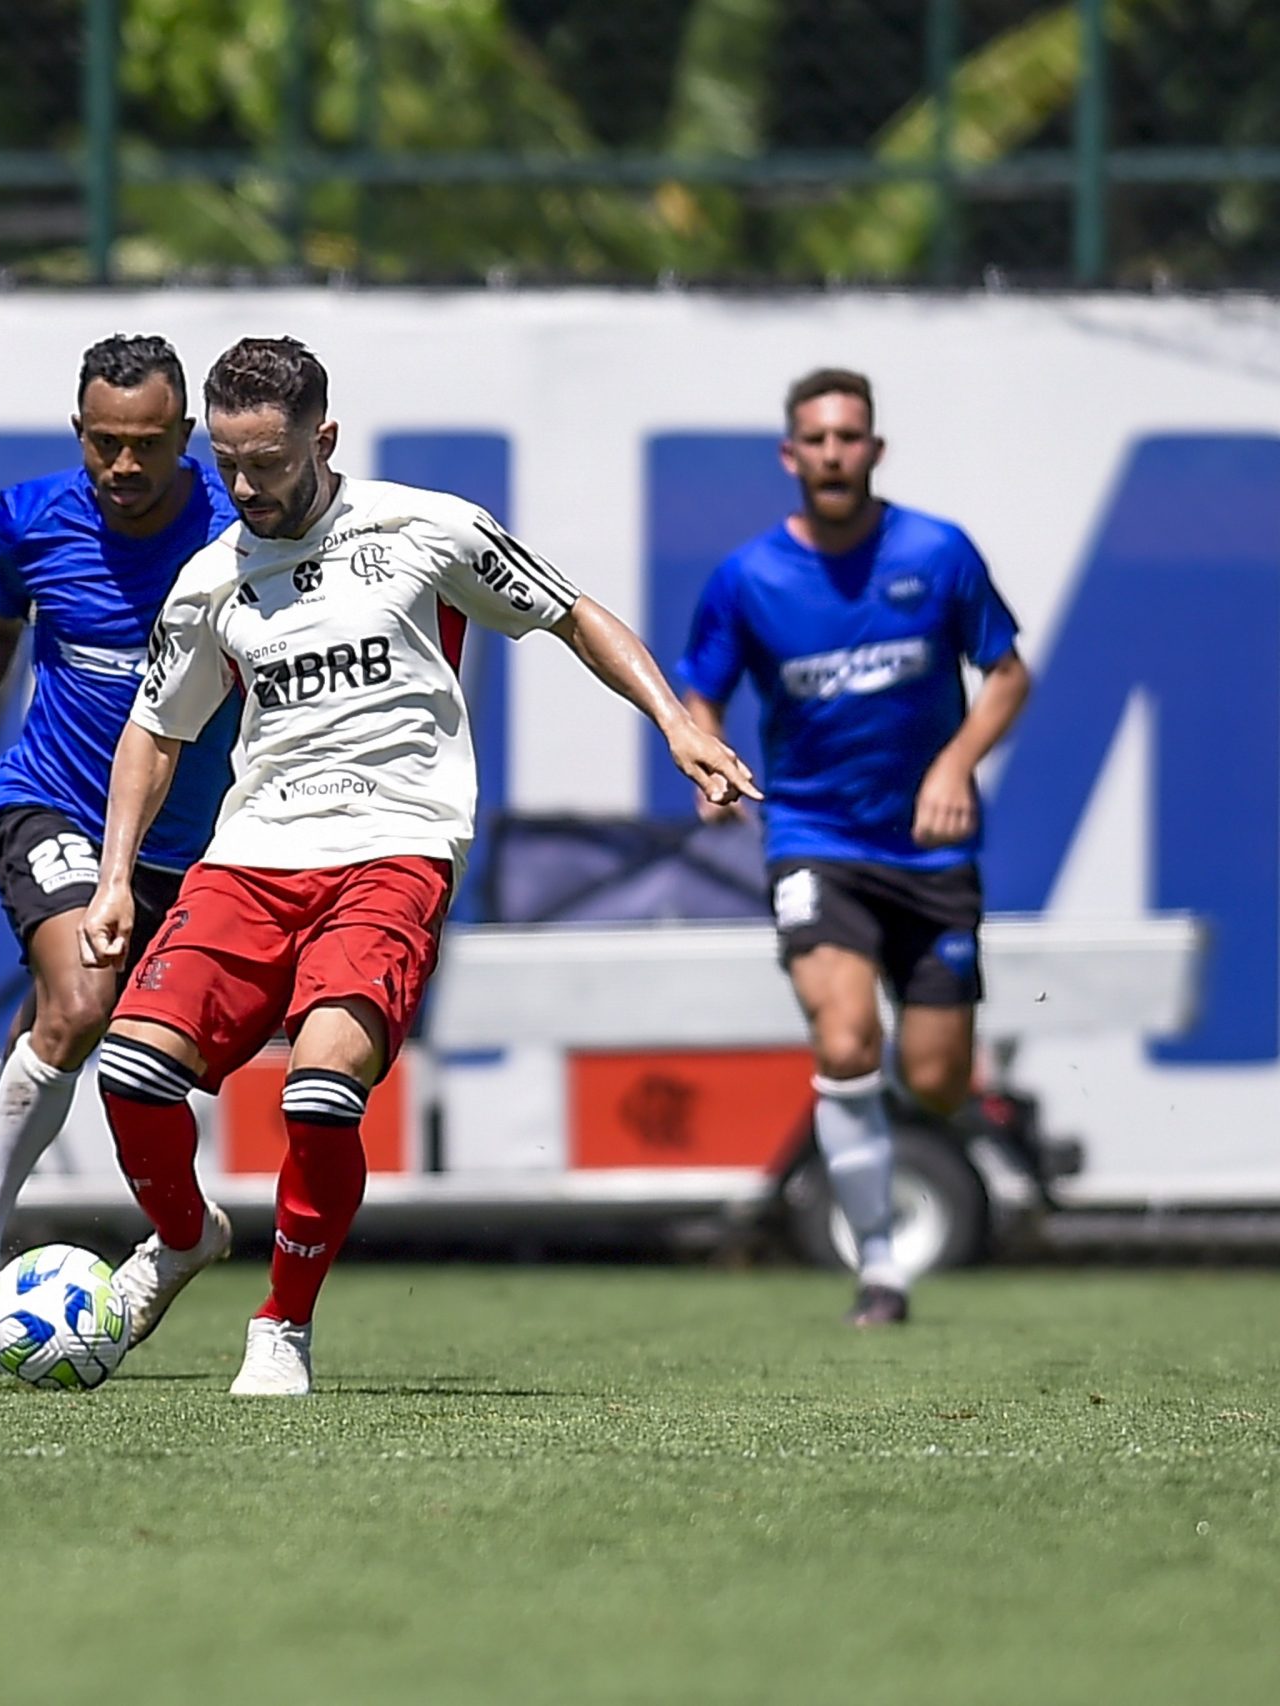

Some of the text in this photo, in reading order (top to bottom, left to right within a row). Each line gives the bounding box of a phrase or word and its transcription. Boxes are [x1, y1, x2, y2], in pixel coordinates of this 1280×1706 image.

[246, 641, 287, 662] banco
[294, 636, 392, 701] BRB
[291, 778, 378, 798] MoonPay
[27, 832, 99, 885] 22
